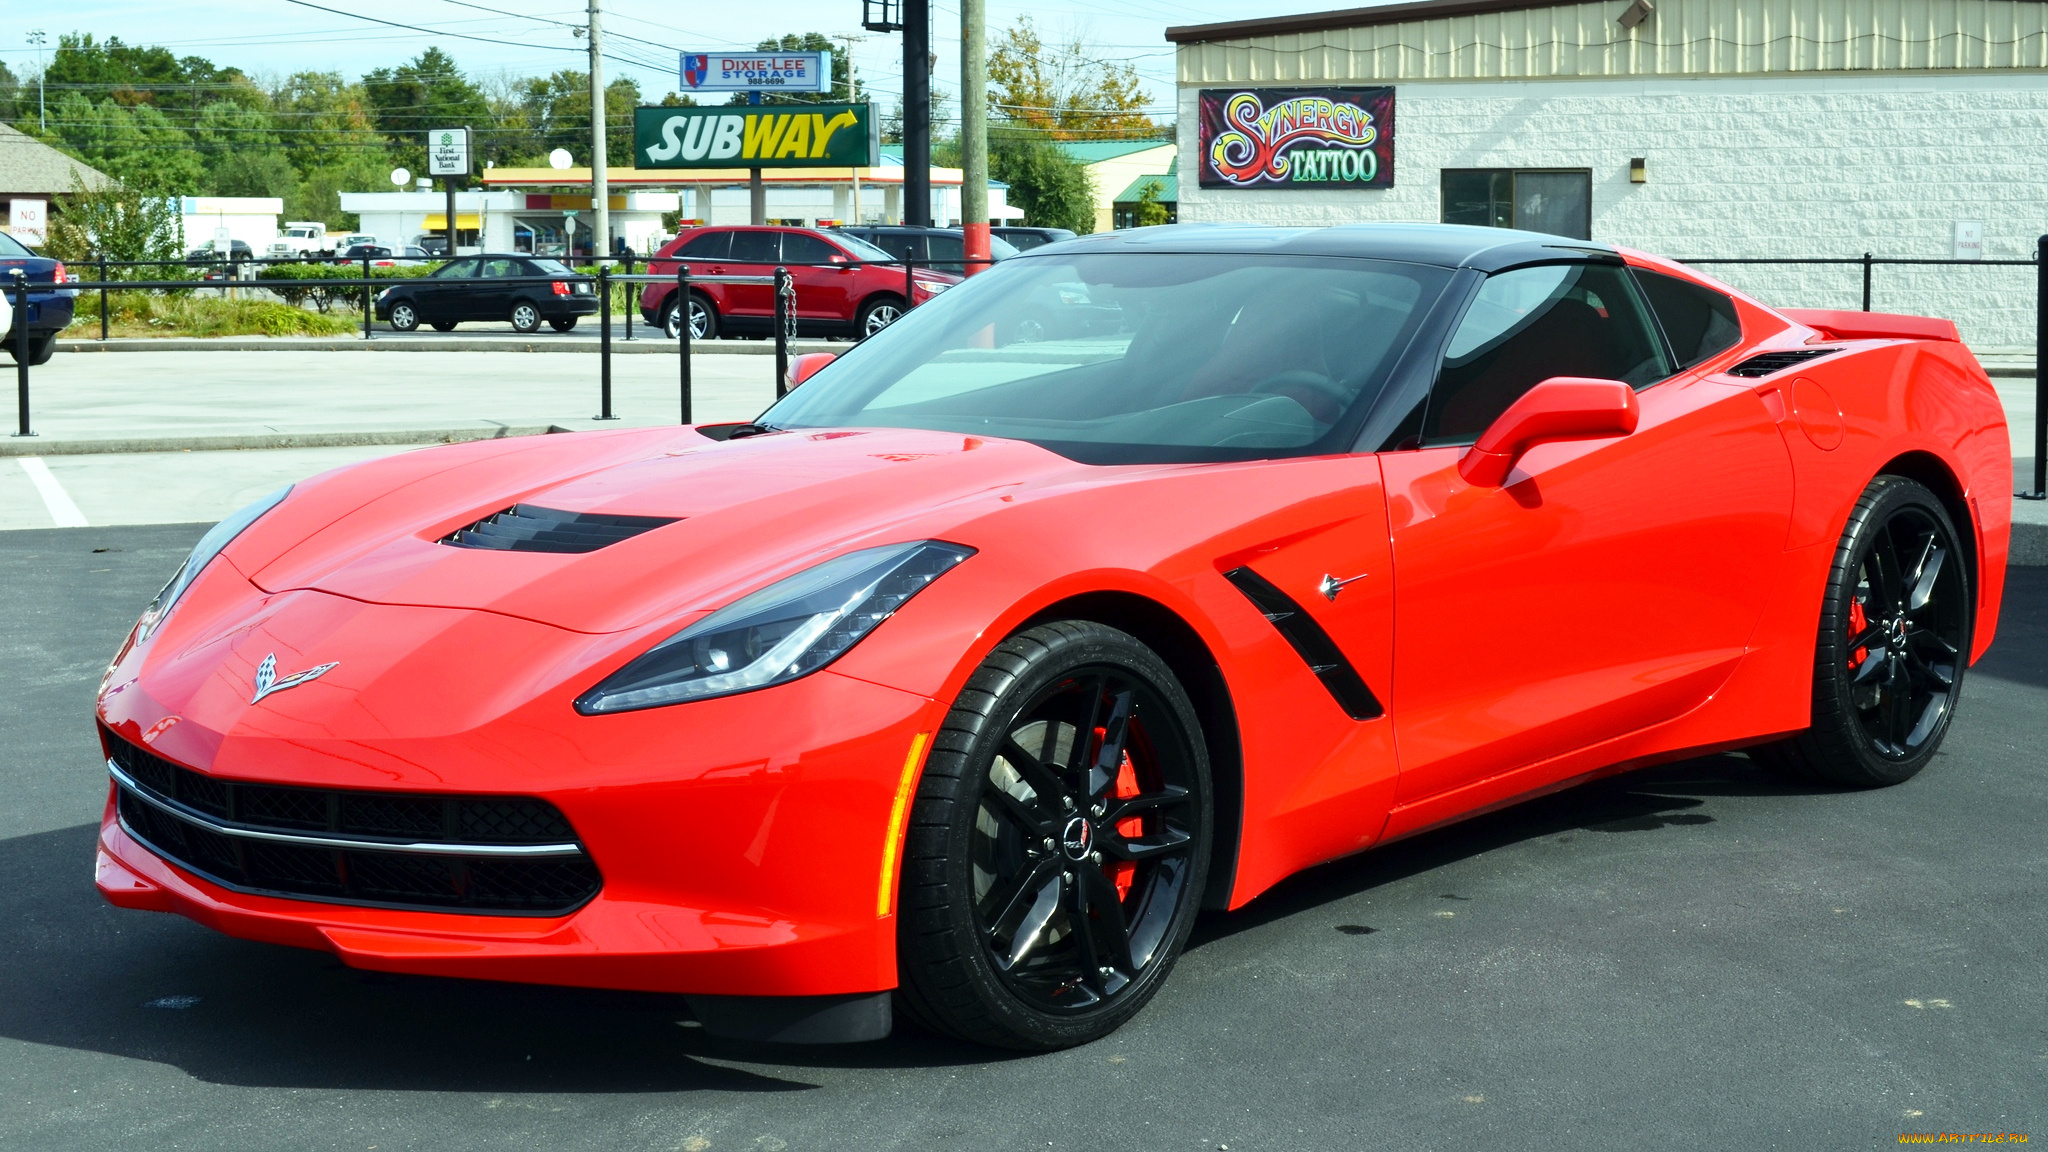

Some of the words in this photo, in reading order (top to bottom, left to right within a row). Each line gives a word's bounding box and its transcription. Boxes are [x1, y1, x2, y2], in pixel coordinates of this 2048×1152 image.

[721, 59, 766, 71] DIXIE
[771, 58, 806, 70] LEE
[721, 70, 806, 79] STORAGE
[747, 77, 785, 85] 988-6696
[645, 109, 858, 164] SUBWAY
[1212, 93, 1377, 184] SYNERGY
[435, 154, 460, 162] National
[439, 161, 456, 169] Bank
[1290, 149, 1377, 181] TATTOO
[20, 210, 36, 221] NO
[12, 226, 44, 236] PARKING
[1957, 241, 1980, 249] PARKING
